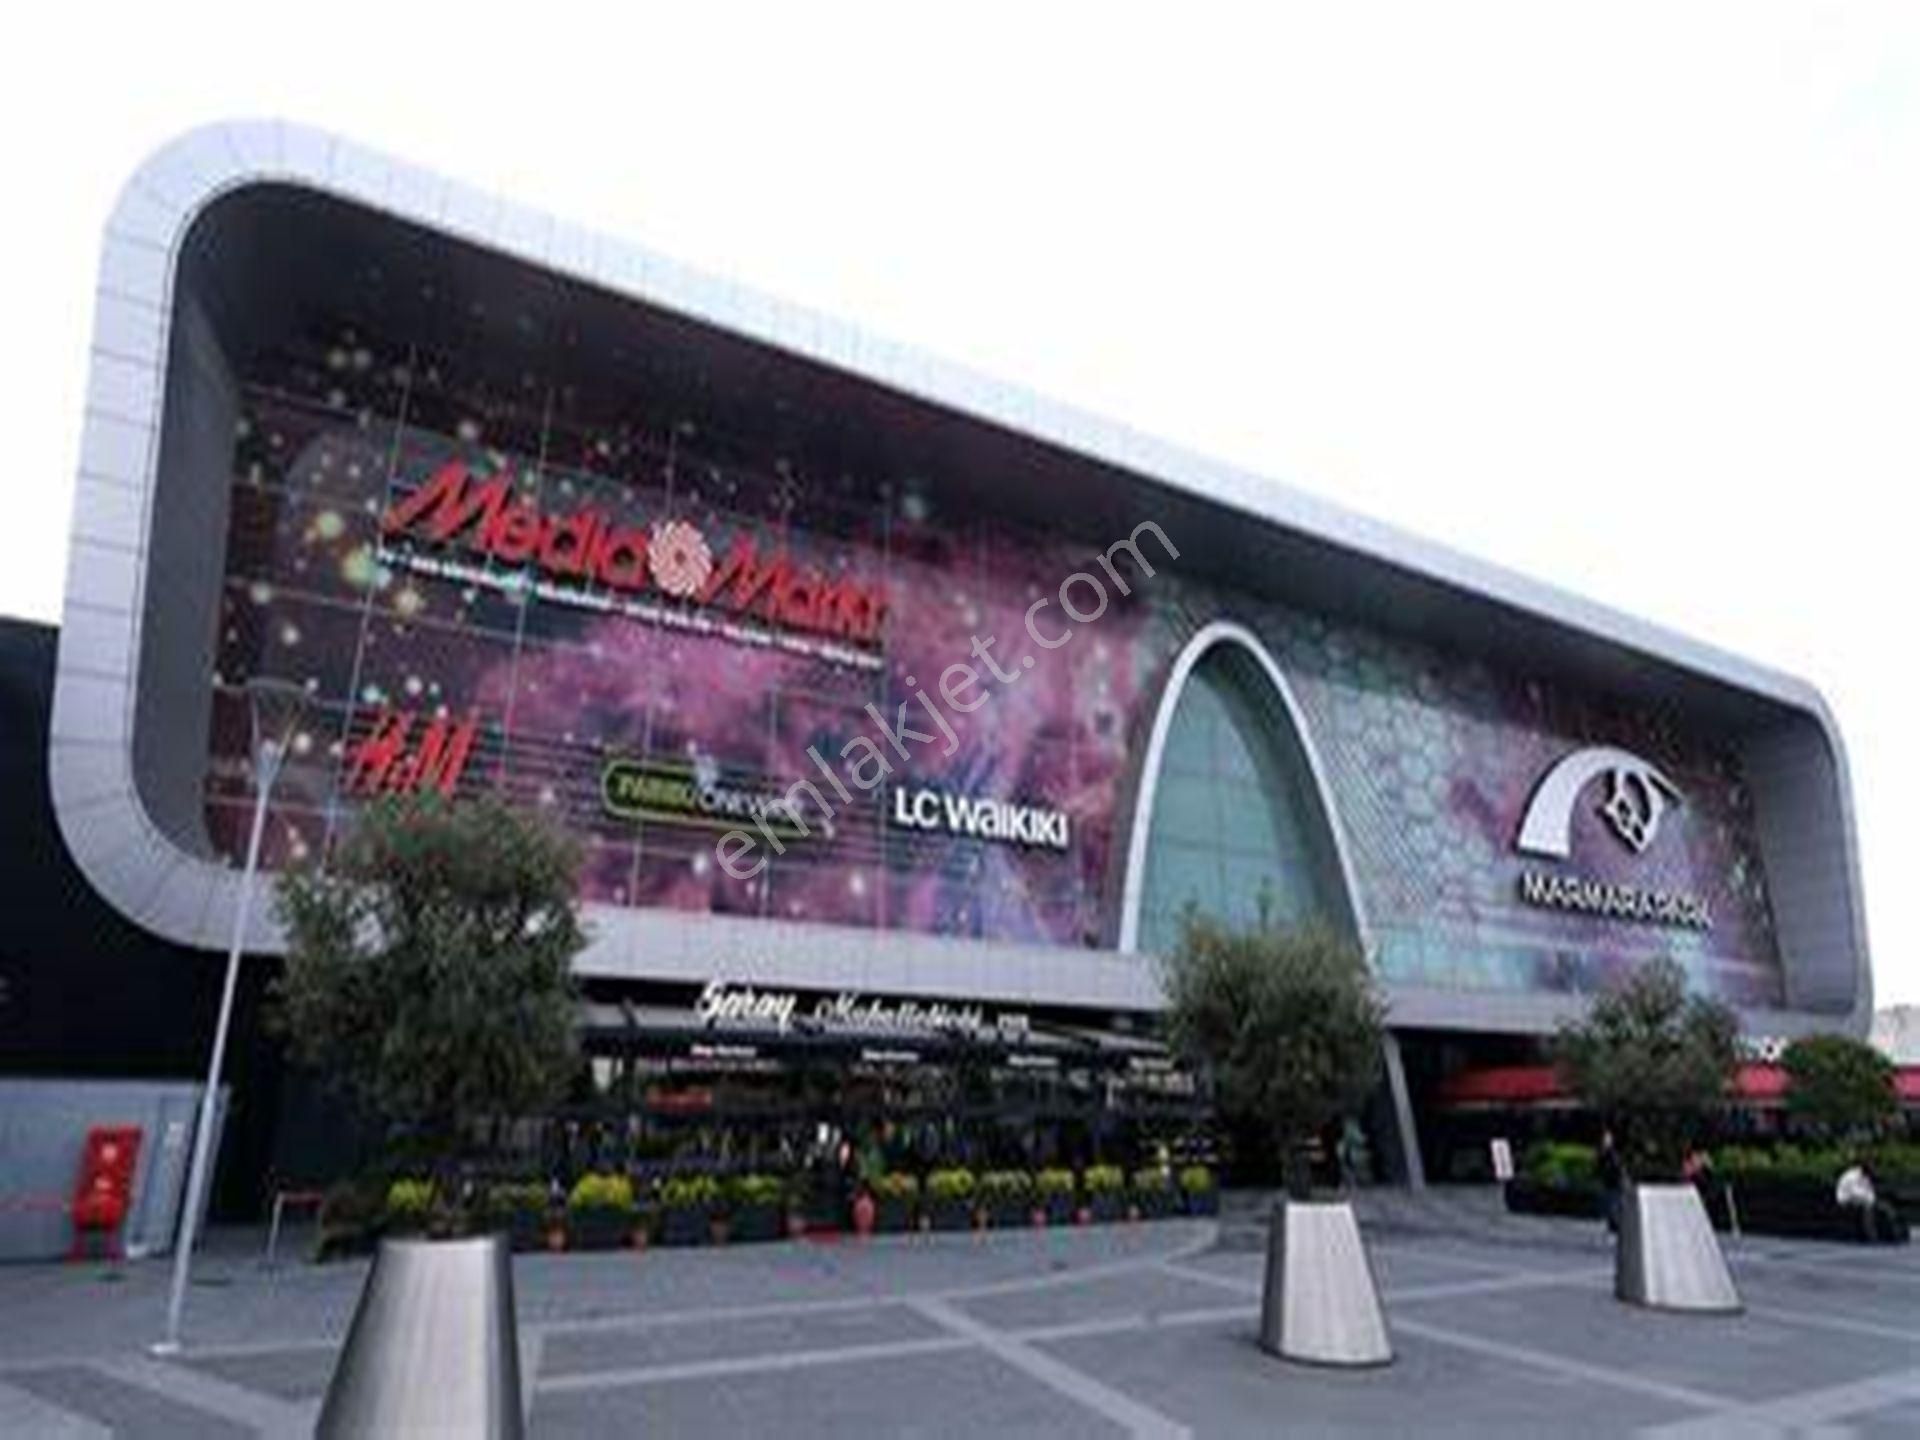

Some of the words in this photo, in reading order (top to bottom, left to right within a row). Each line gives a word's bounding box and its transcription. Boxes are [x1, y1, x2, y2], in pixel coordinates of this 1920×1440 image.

[383, 455, 649, 589] Media
[344, 712, 476, 799] H&M
[896, 787, 939, 828] LC
[697, 980, 797, 1038] Saray
